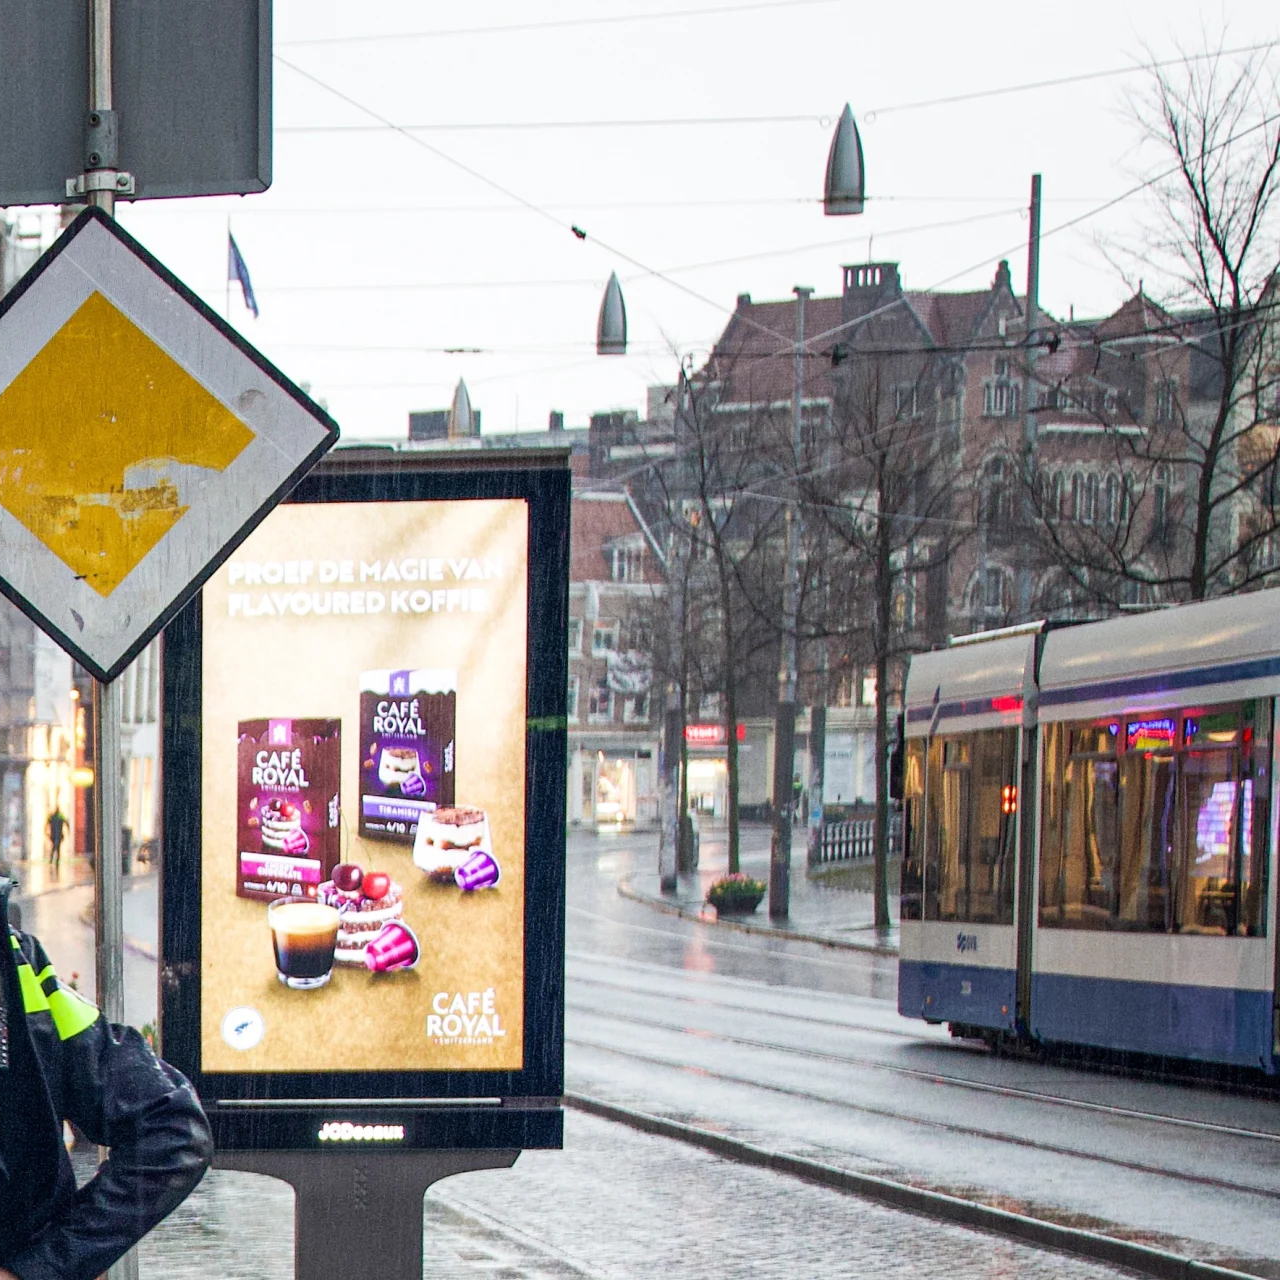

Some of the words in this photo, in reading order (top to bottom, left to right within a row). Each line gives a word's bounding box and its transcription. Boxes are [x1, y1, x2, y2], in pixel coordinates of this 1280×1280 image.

[228, 560, 314, 586] PROEF
[319, 560, 355, 584] DE
[360, 558, 443, 583] MAGIE
[448, 556, 504, 581] VAN
[228, 590, 385, 617] FLAVOURED
[391, 588, 488, 614] KOFFIE
[377, 699, 420, 719] CAFÉ
[374, 716, 426, 735] ROYAL
[256, 748, 302, 770] CAFÉ
[252, 767, 309, 788] ROYAL
[379, 805, 418, 818] TIRAMISU
[432, 987, 496, 1015] CAFÉ
[426, 1013, 506, 1037] ROYAL
